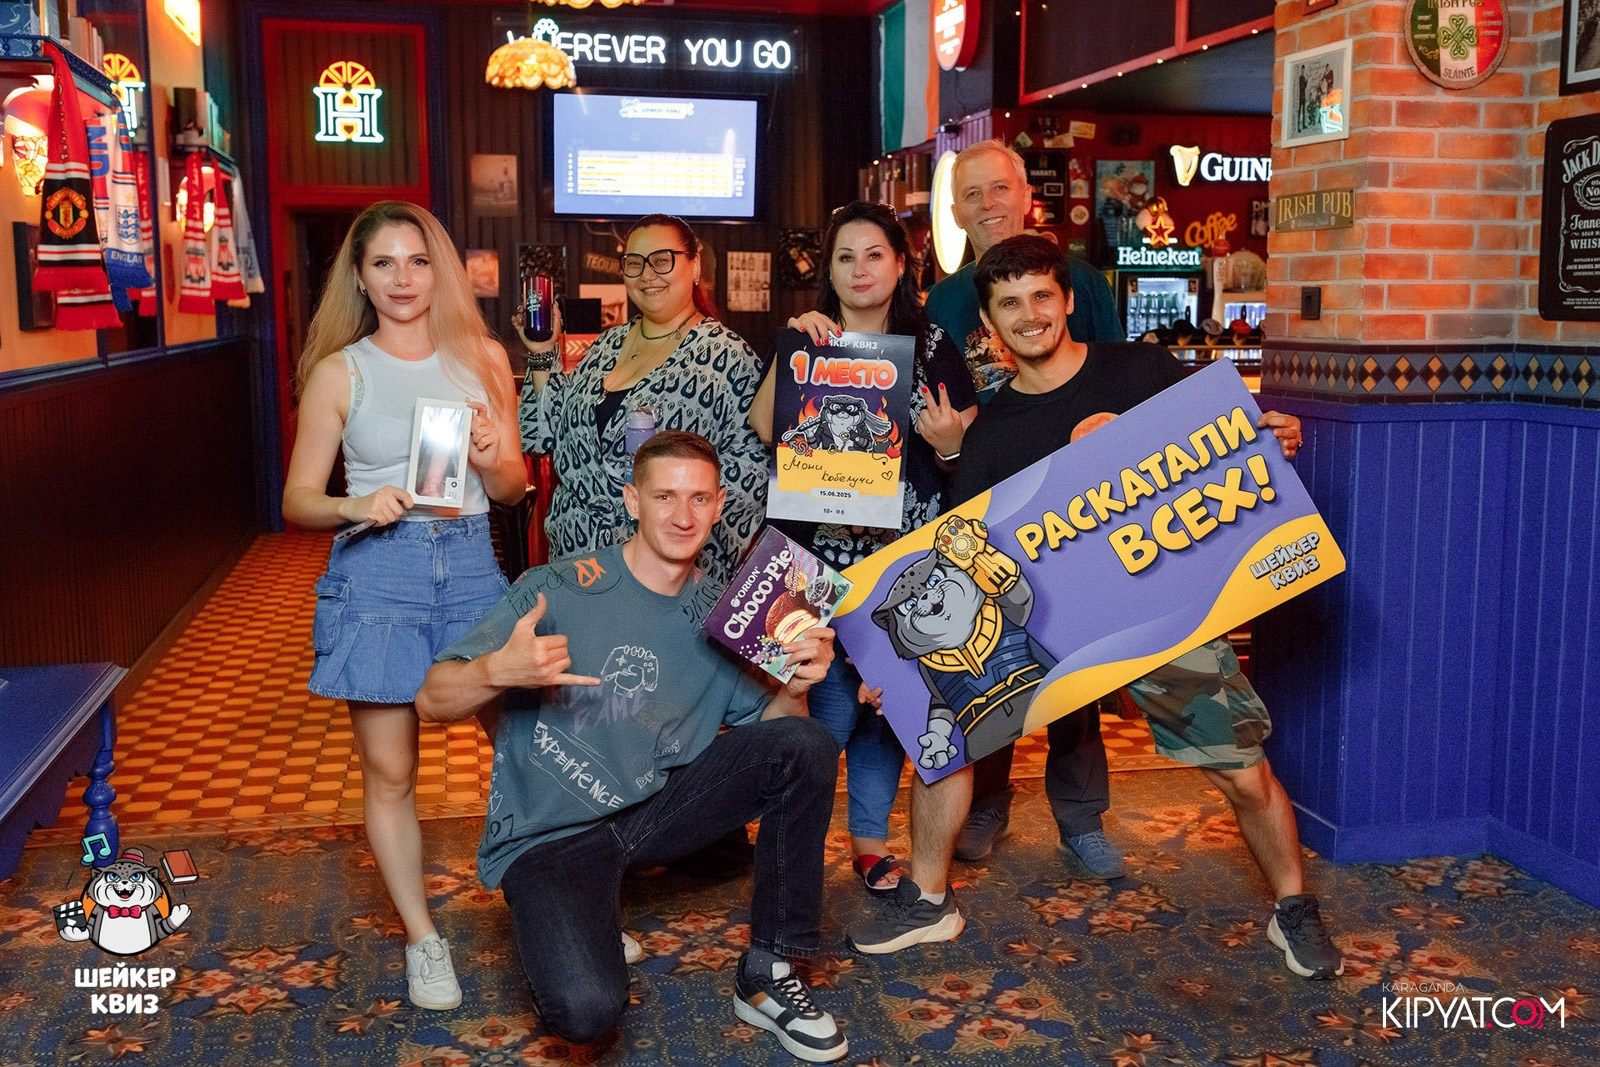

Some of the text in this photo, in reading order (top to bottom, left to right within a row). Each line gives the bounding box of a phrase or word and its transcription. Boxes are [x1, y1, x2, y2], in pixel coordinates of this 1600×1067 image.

[684, 38, 742, 67] YOU
[753, 40, 791, 69] GO
[1443, 67, 1476, 79] SLÁINTE
[1562, 149, 1592, 183] JACK
[1278, 191, 1352, 224] IRISH PUB
[1185, 212, 1238, 248] Coffee
[1117, 247, 1201, 265] Heineken
[853, 340, 878, 350] КВИЗ
[790, 351, 898, 390] 1 МЕСТО
[783, 455, 823, 470] Мони
[1014, 406, 1258, 562] РАСКАТАЛИ
[1108, 454, 1277, 576] ВСЕХ!
[1249, 532, 1320, 579] ШЕЙКЕР
[1269, 554, 1320, 590] КВИЗ
[737, 568, 761, 599] ORION
